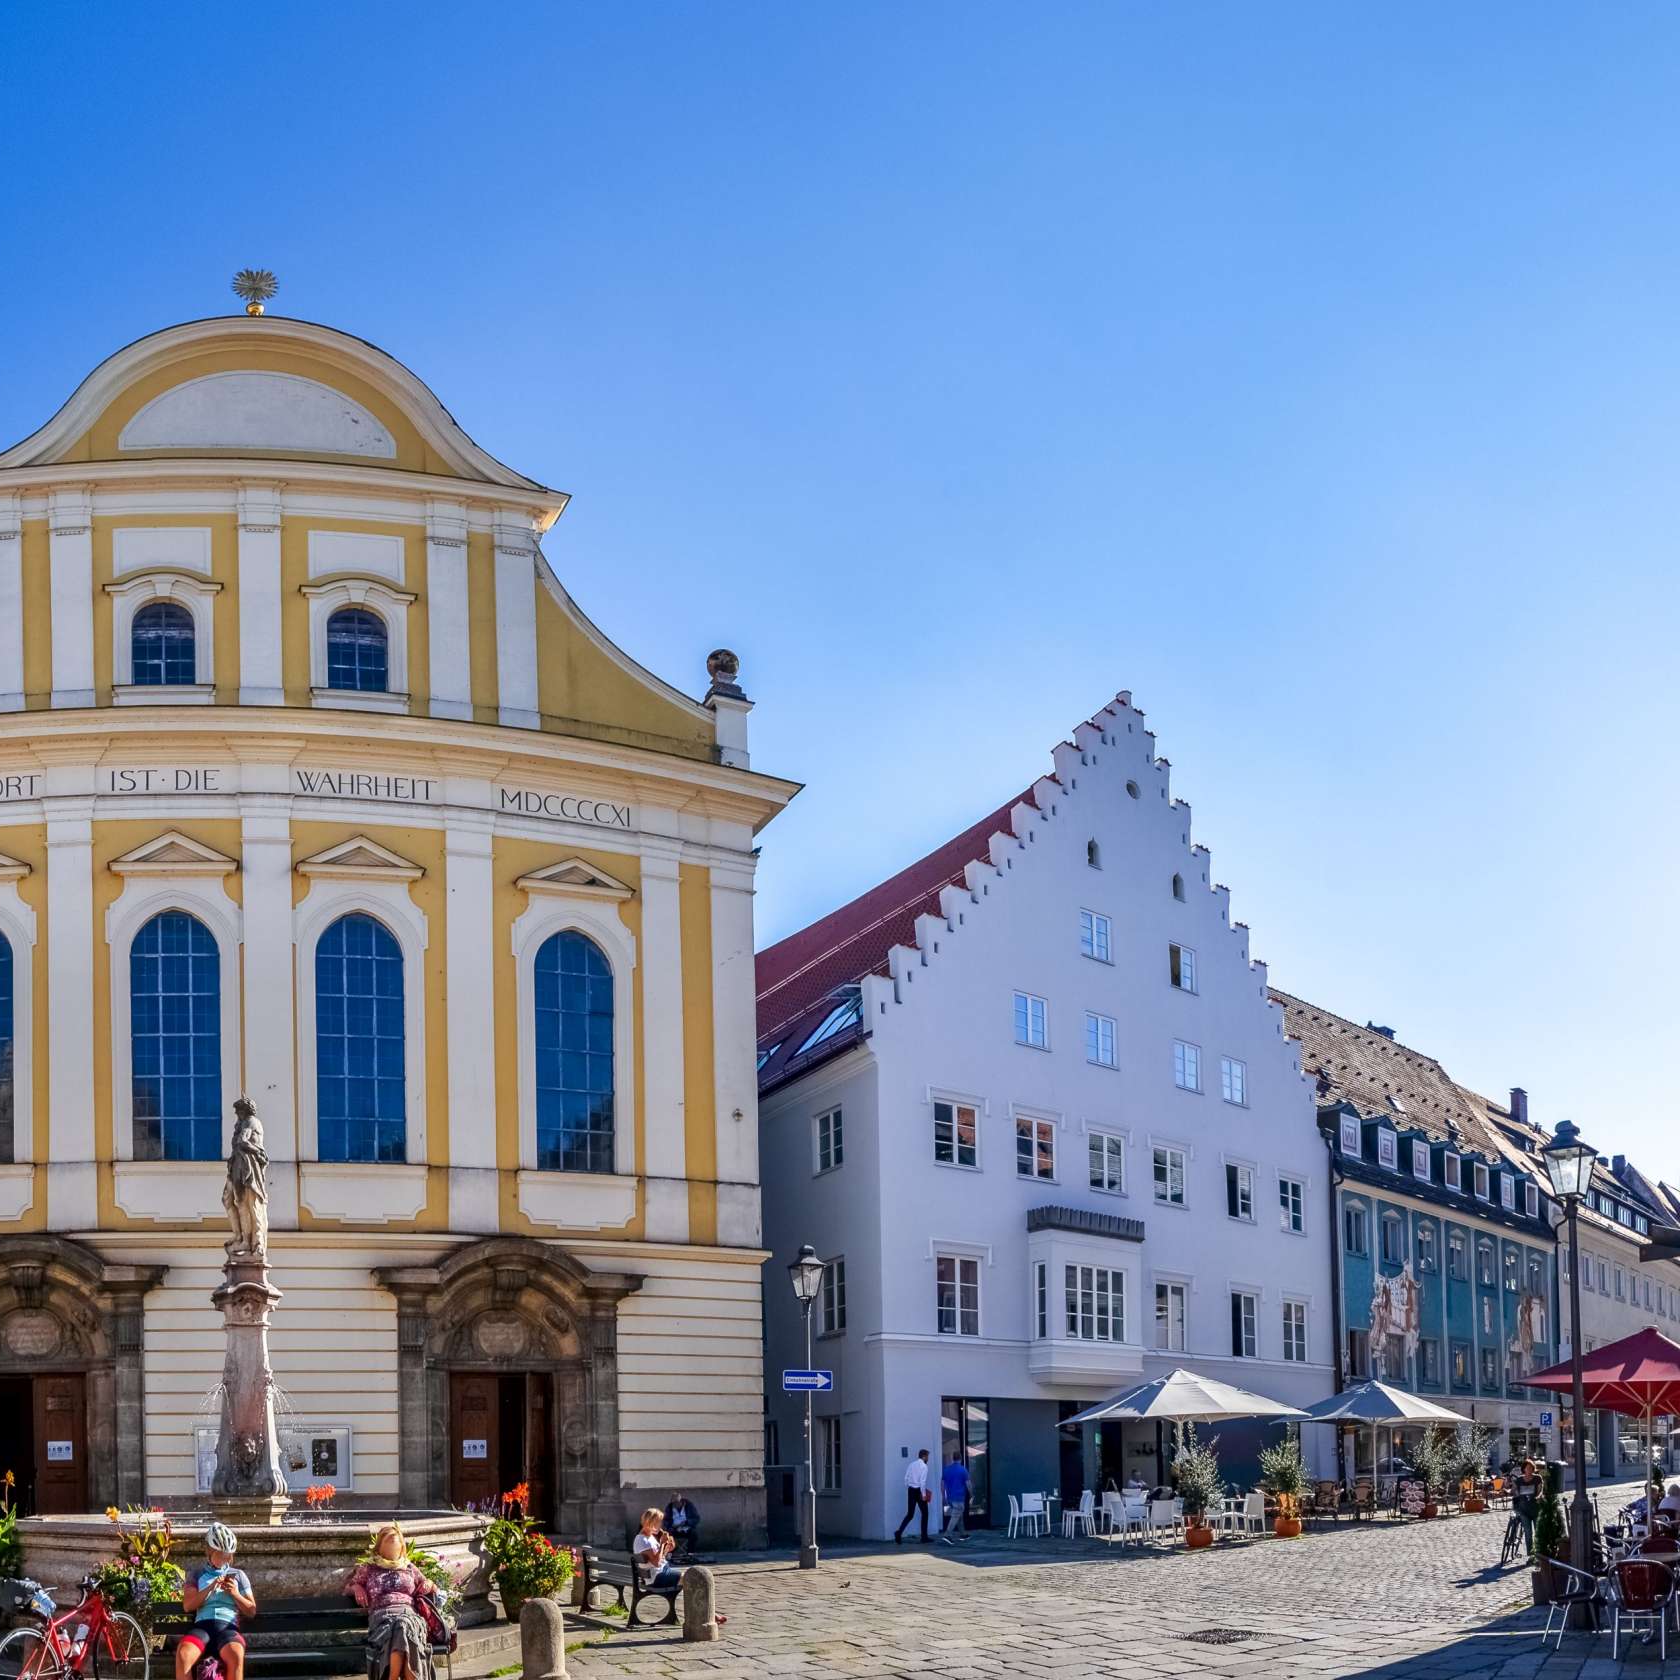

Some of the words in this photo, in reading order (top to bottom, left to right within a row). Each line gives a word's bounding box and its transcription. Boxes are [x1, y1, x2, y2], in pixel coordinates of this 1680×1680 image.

[111, 769, 158, 792] IST
[175, 769, 220, 791] DIE
[296, 770, 438, 800] WAHRHEIT
[500, 788, 630, 828] MDCCCCXI
